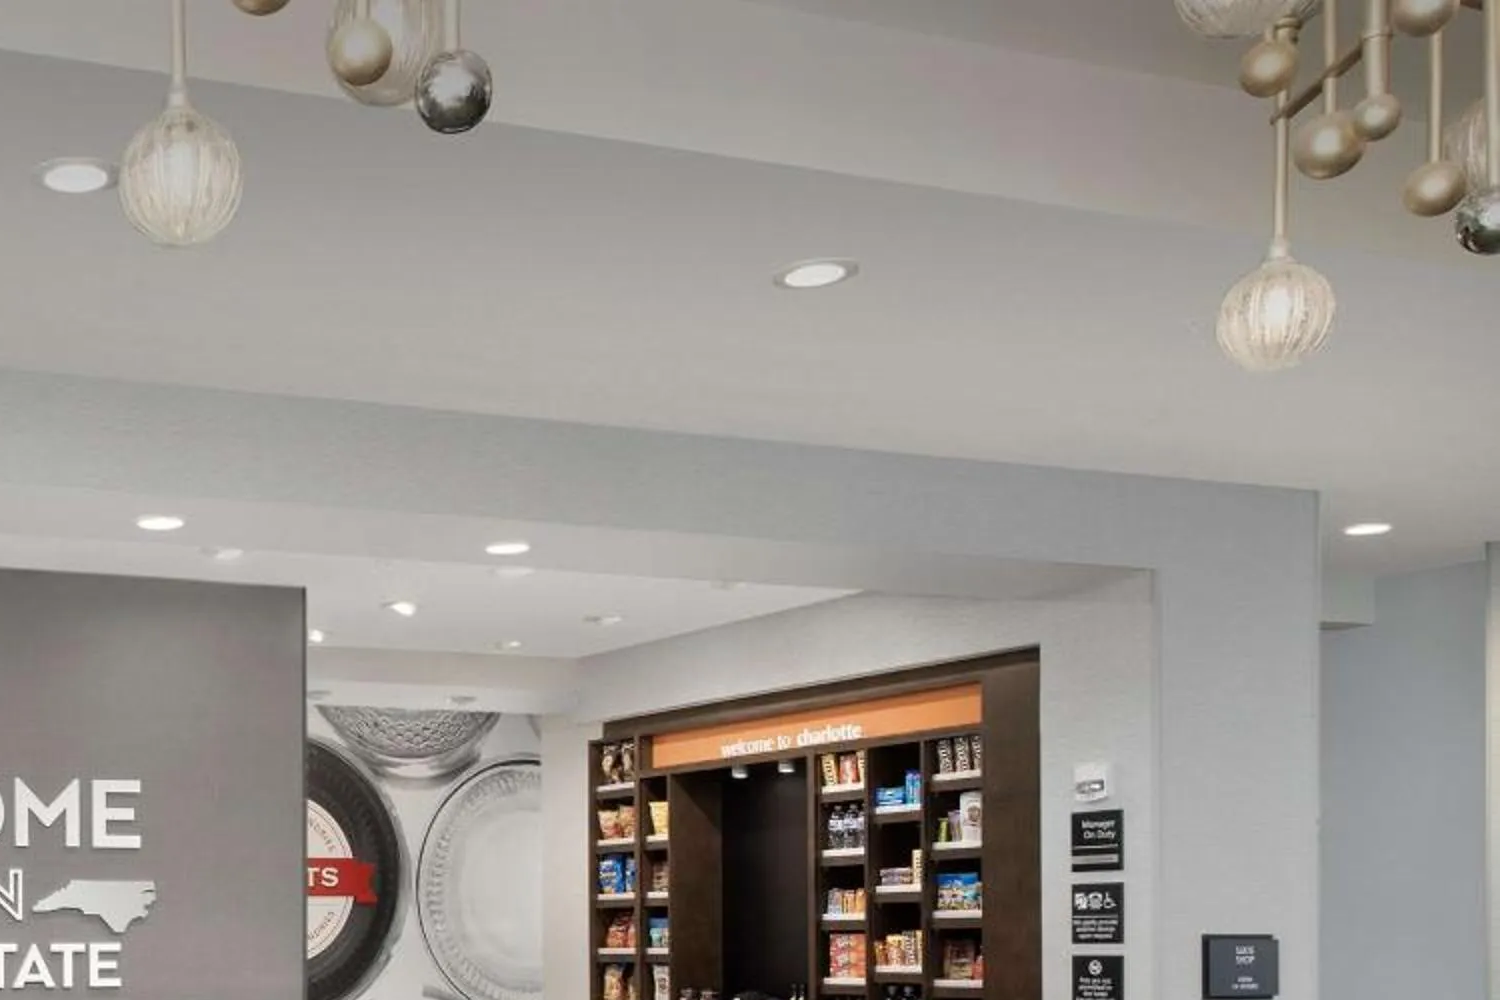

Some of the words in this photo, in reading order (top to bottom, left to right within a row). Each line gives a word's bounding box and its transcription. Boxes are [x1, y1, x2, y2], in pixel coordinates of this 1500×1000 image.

[721, 738, 775, 758] welcome
[777, 735, 792, 750] to
[797, 724, 863, 747] charlotte
[307, 866, 339, 888] TS
